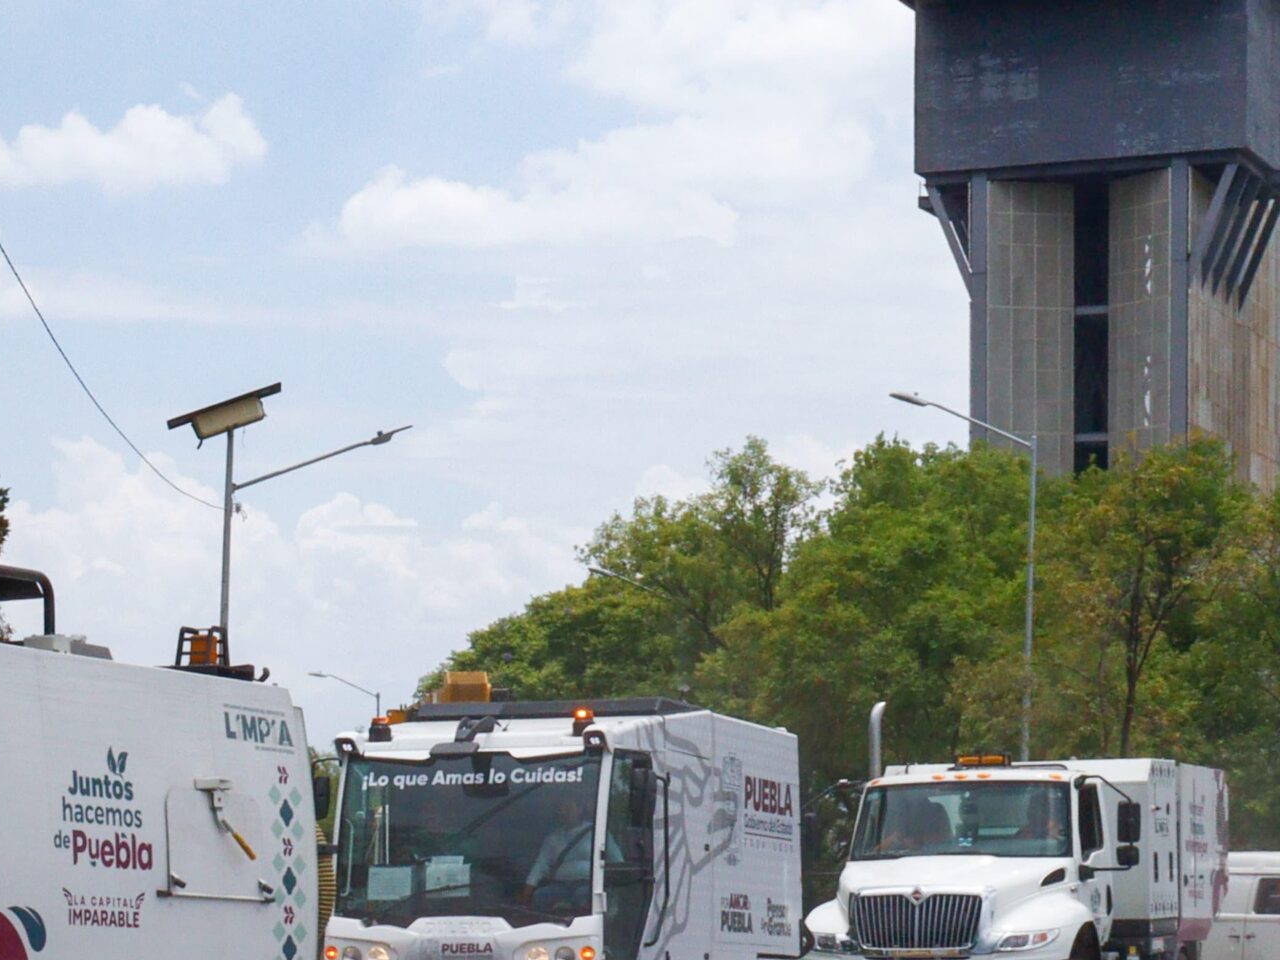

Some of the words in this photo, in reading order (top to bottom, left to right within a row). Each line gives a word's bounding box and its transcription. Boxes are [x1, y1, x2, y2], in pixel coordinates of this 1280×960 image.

[68, 770, 134, 801] Juntos
[362, 771, 389, 790] ¡Lo
[393, 773, 429, 790] que
[432, 770, 484, 786] Amas
[488, 768, 506, 784] lo
[510, 767, 584, 784] Cuidas!
[744, 776, 793, 817] PUEBLA
[62, 797, 143, 829] hacemos
[53, 830, 71, 849] de
[72, 829, 153, 870] Puebla
[73, 895, 86, 906] LA
[91, 895, 134, 909] CAPITAL
[68, 909, 140, 928] IMPARABLE
[721, 910, 753, 934] PUEBLA
[441, 942, 493, 954] PUEBLA
